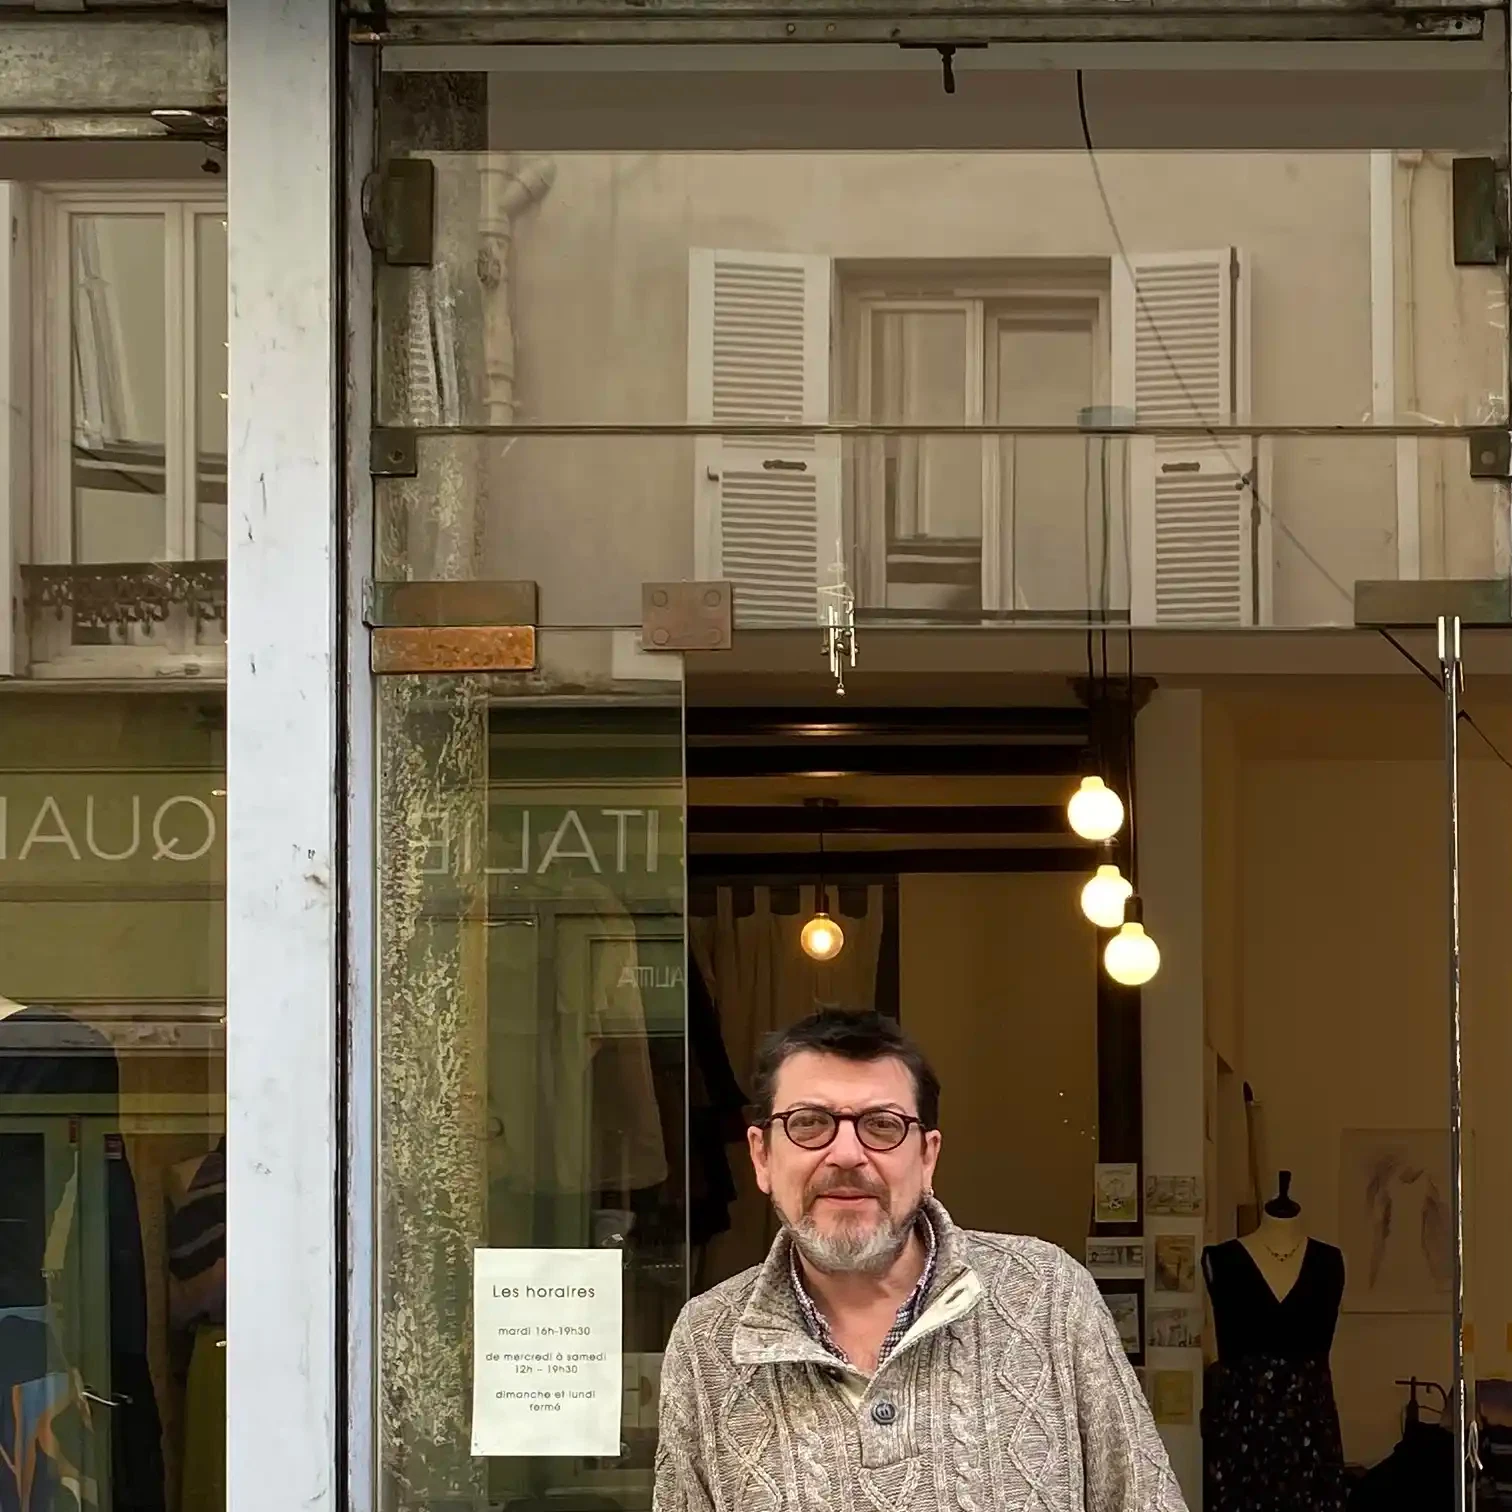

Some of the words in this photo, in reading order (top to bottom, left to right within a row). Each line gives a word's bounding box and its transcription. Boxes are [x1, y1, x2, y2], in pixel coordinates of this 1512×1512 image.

[492, 1284, 520, 1299] Les
[526, 1284, 596, 1299] horaires
[498, 1326, 531, 1337] mardi
[536, 1326, 591, 1337] 16h-19h30
[485, 1352, 500, 1362] de
[503, 1352, 553, 1362] mercredi
[566, 1352, 608, 1362] samedi
[515, 1364, 534, 1375] 12h
[547, 1364, 579, 1375] 19h30
[495, 1390, 552, 1400] dimanche
[554, 1390, 566, 1400] et
[568, 1390, 597, 1400] lundi
